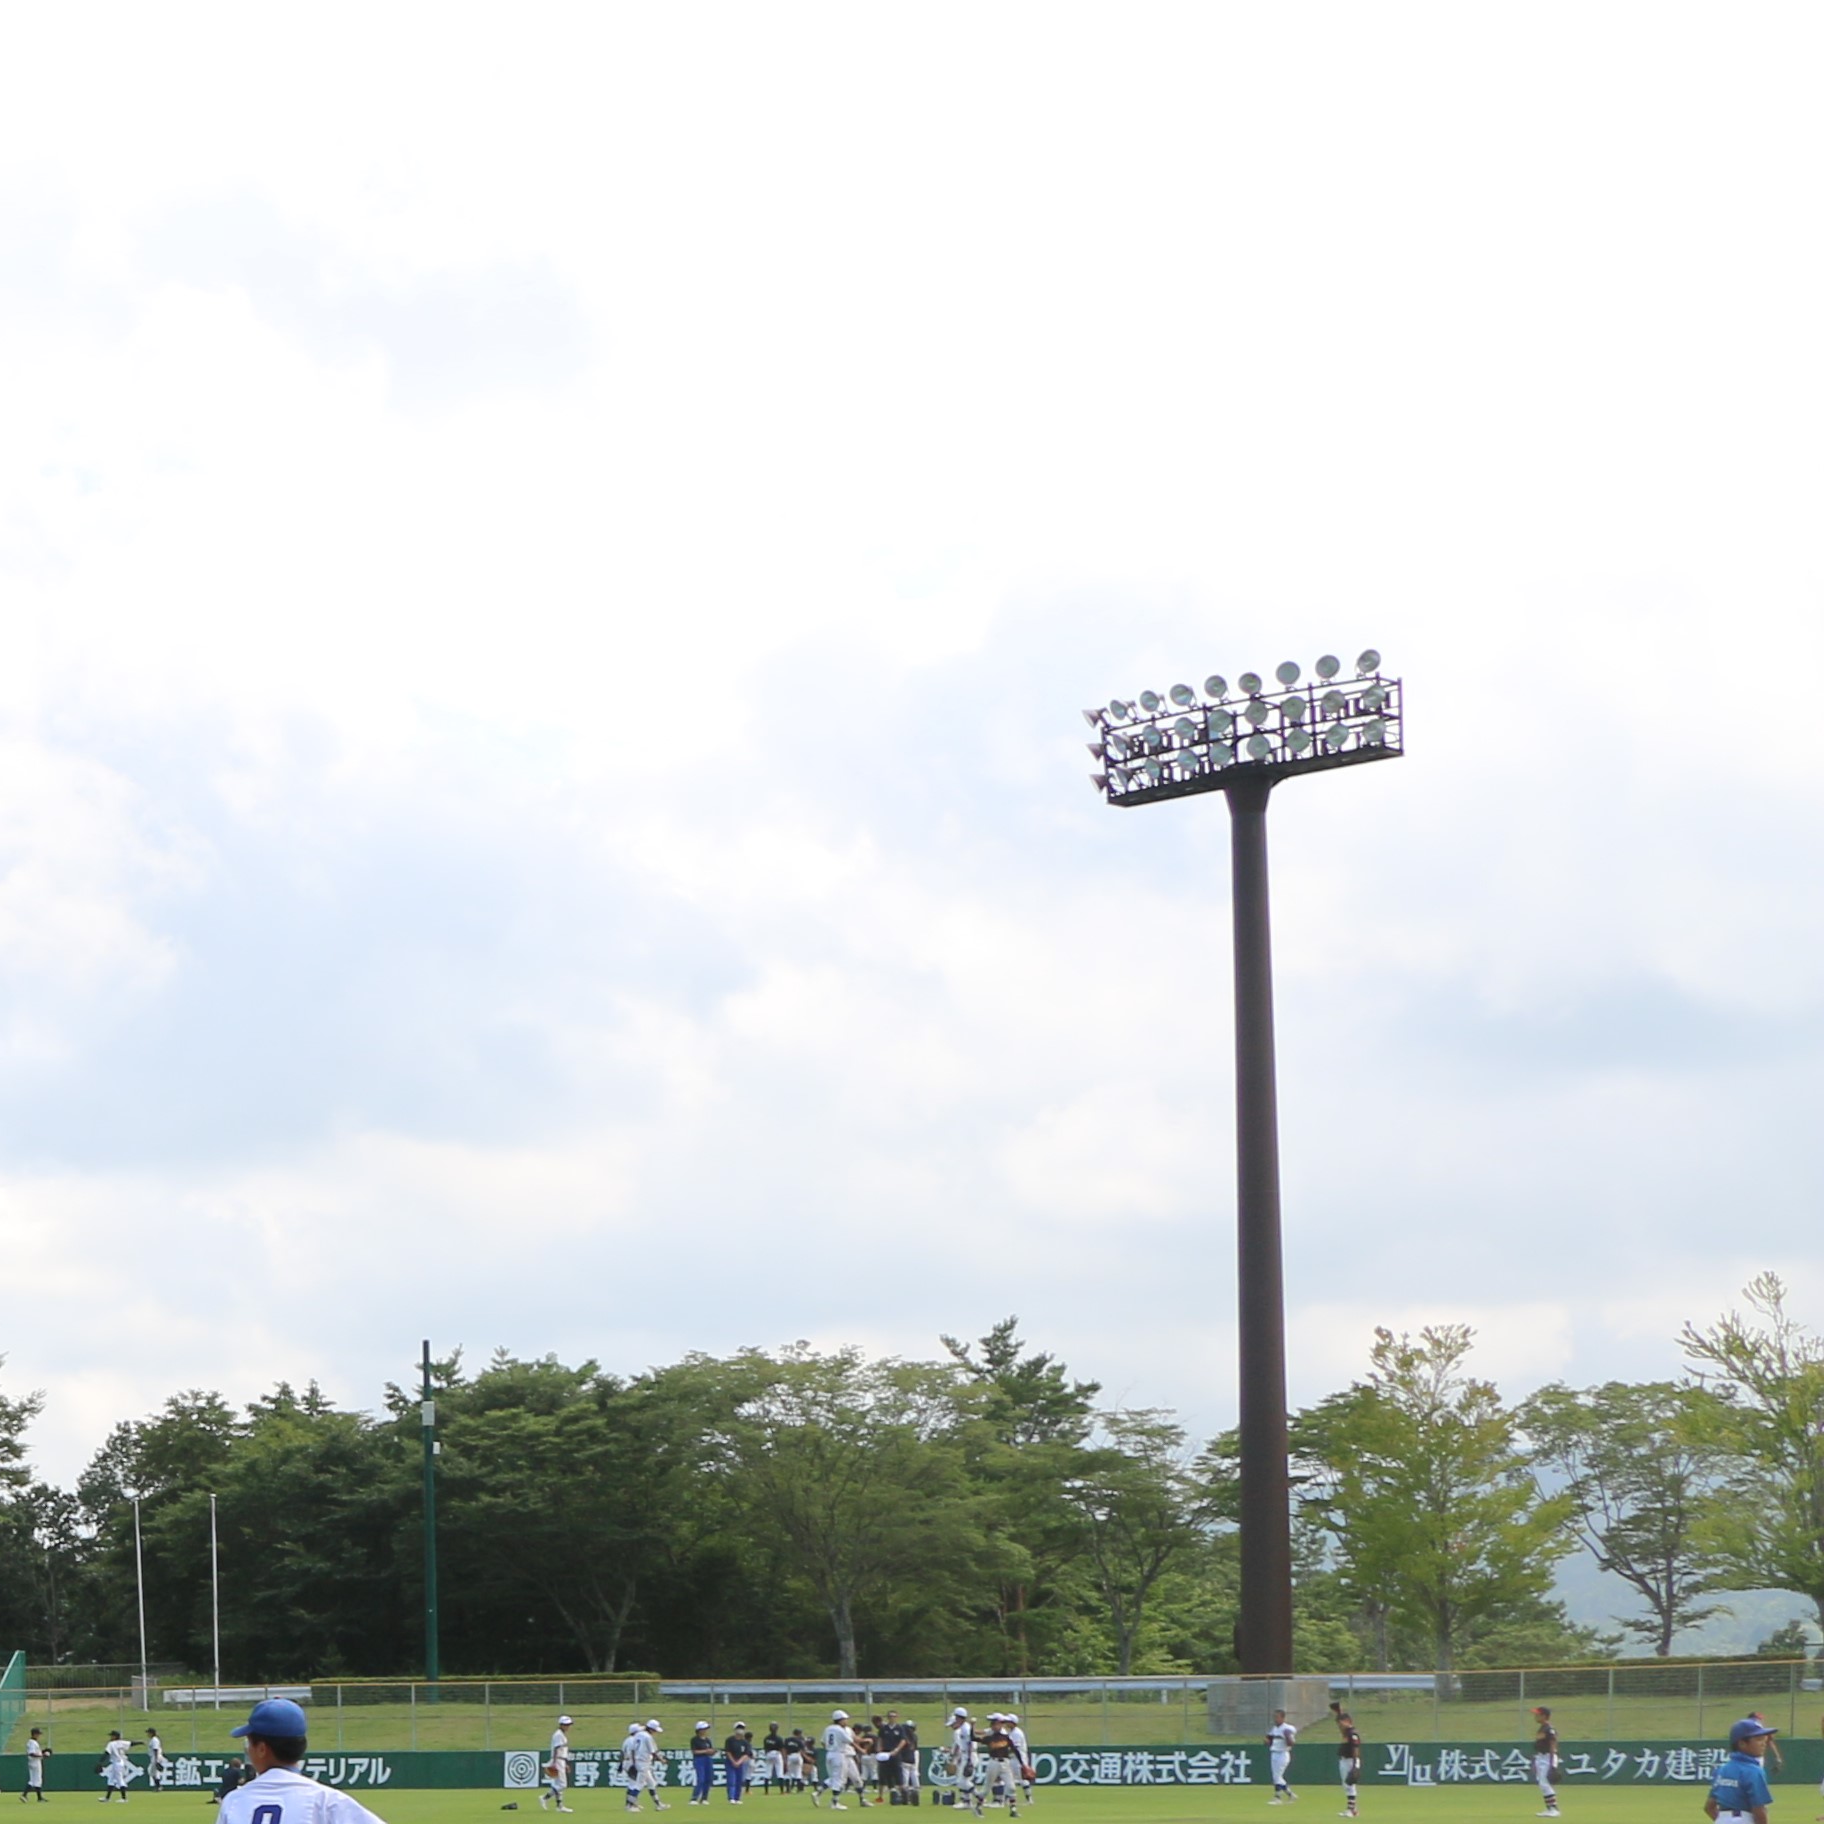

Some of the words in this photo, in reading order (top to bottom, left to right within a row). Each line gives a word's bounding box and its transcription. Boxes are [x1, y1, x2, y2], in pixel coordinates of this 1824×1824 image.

[149, 1756, 392, 1787] 住鉱エテリアル
[1437, 1748, 1732, 1783] 株式会ユタカ建設
